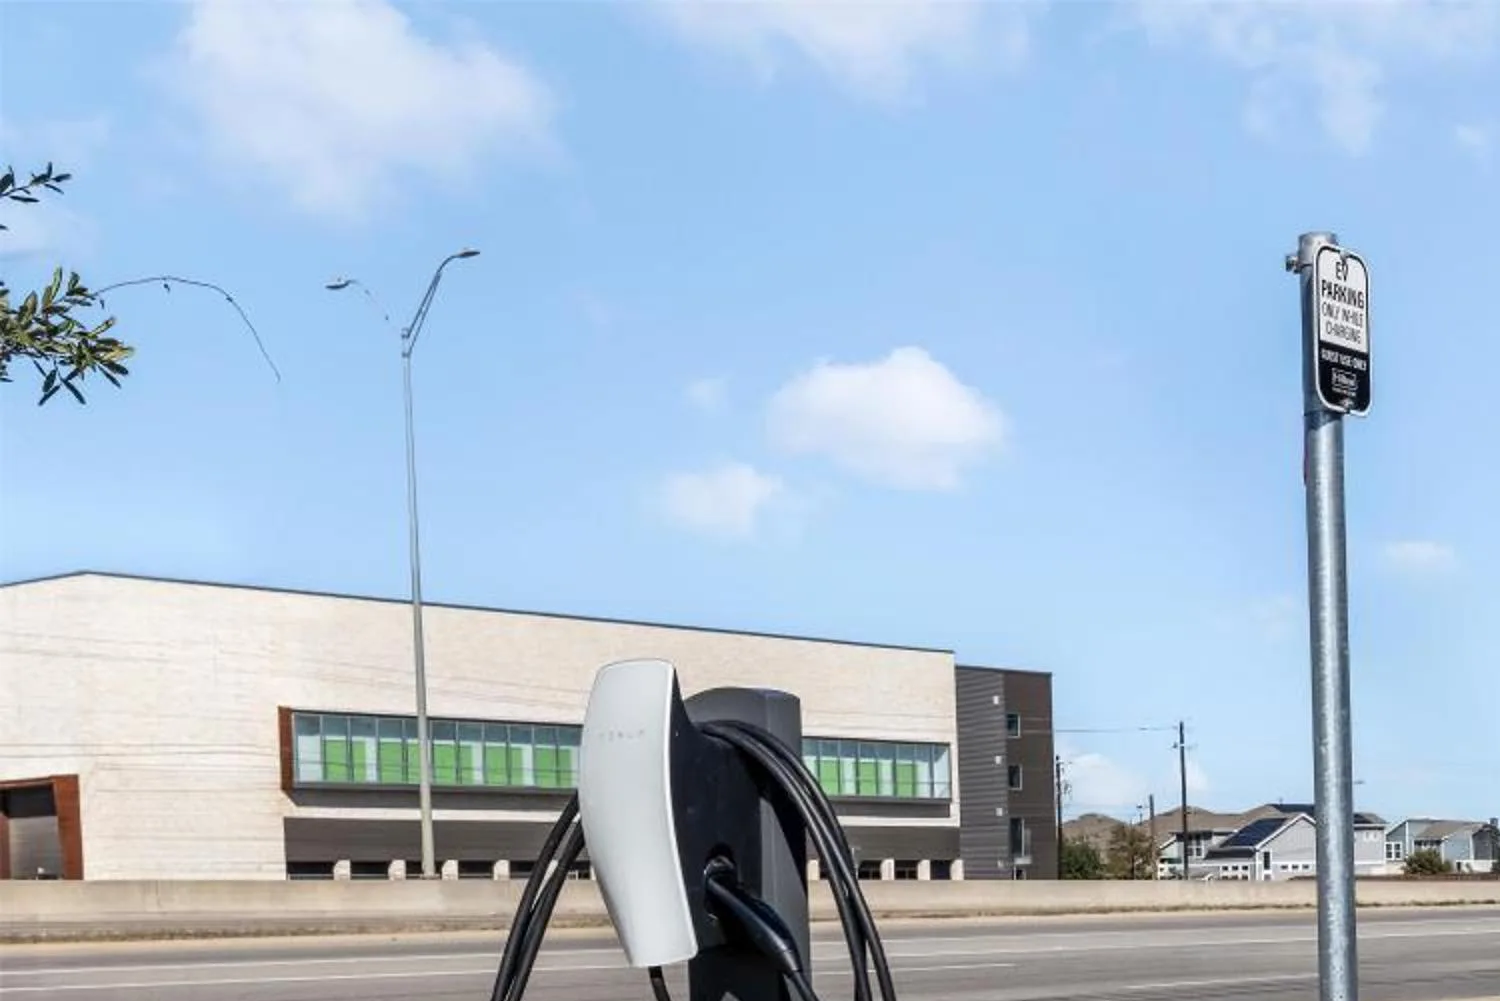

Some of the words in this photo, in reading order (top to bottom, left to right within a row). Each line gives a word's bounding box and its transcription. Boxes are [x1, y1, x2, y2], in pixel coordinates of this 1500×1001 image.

[1335, 261, 1349, 281] EV
[1321, 279, 1364, 309] PARKING
[1321, 301, 1340, 321] ONLY
[1325, 320, 1362, 344] CHARGING
